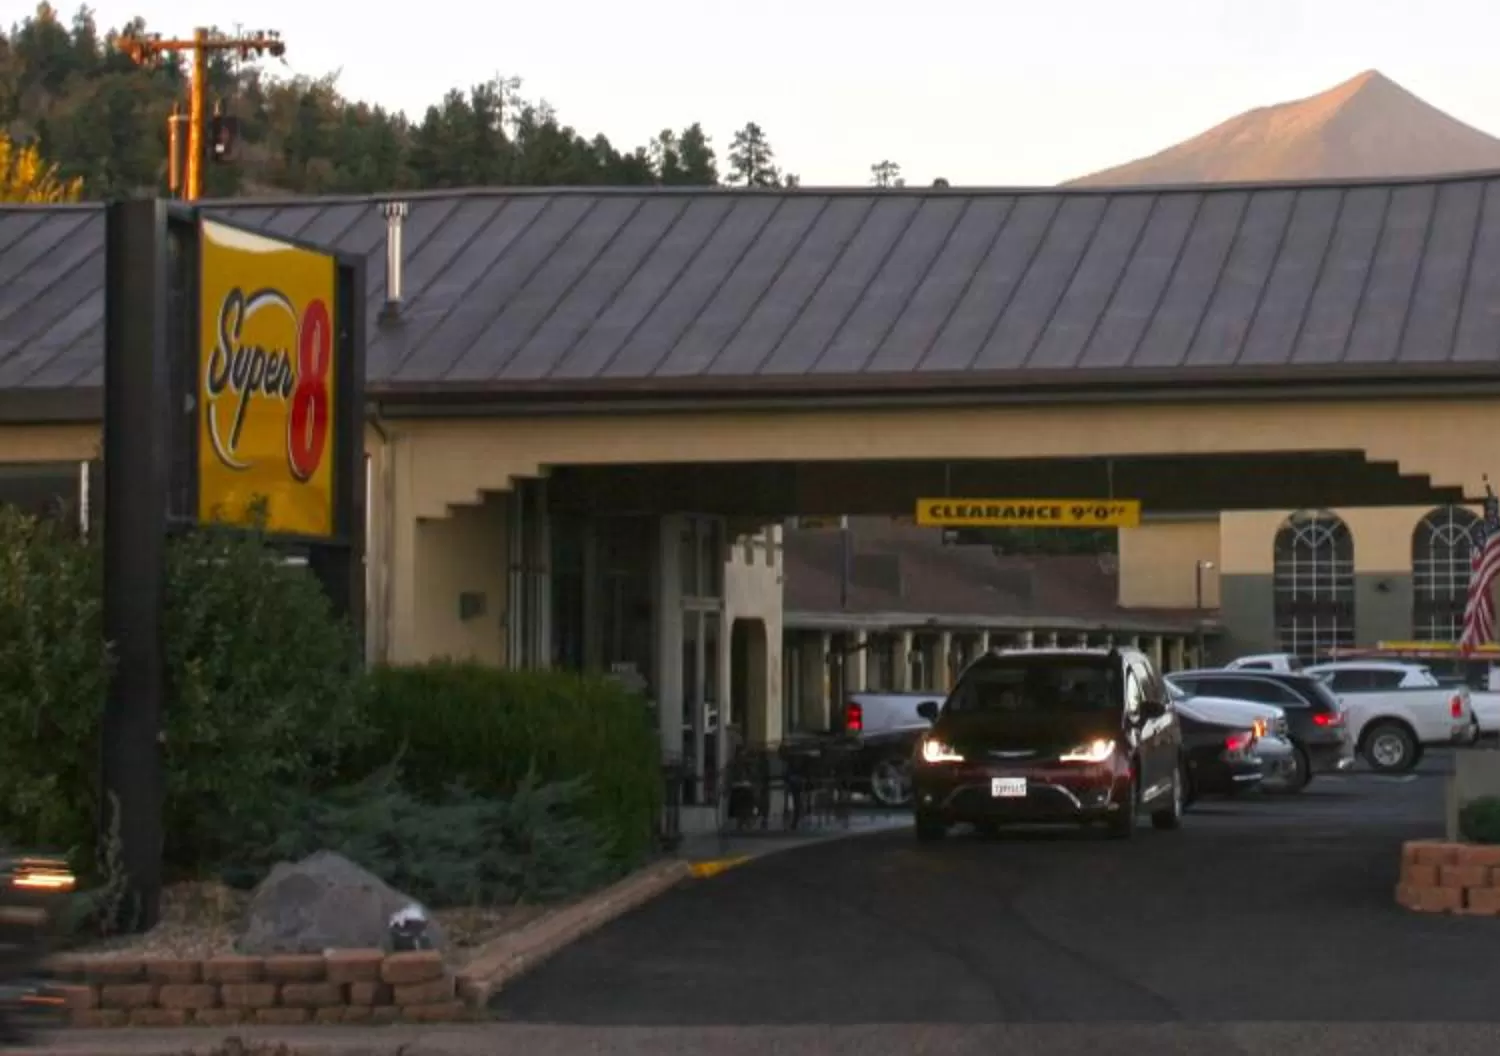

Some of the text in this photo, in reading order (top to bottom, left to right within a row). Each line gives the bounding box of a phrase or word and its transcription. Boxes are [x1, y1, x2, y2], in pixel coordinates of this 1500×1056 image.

[207, 288, 331, 482] Super 8
[928, 504, 1062, 520] CLEARANCE
